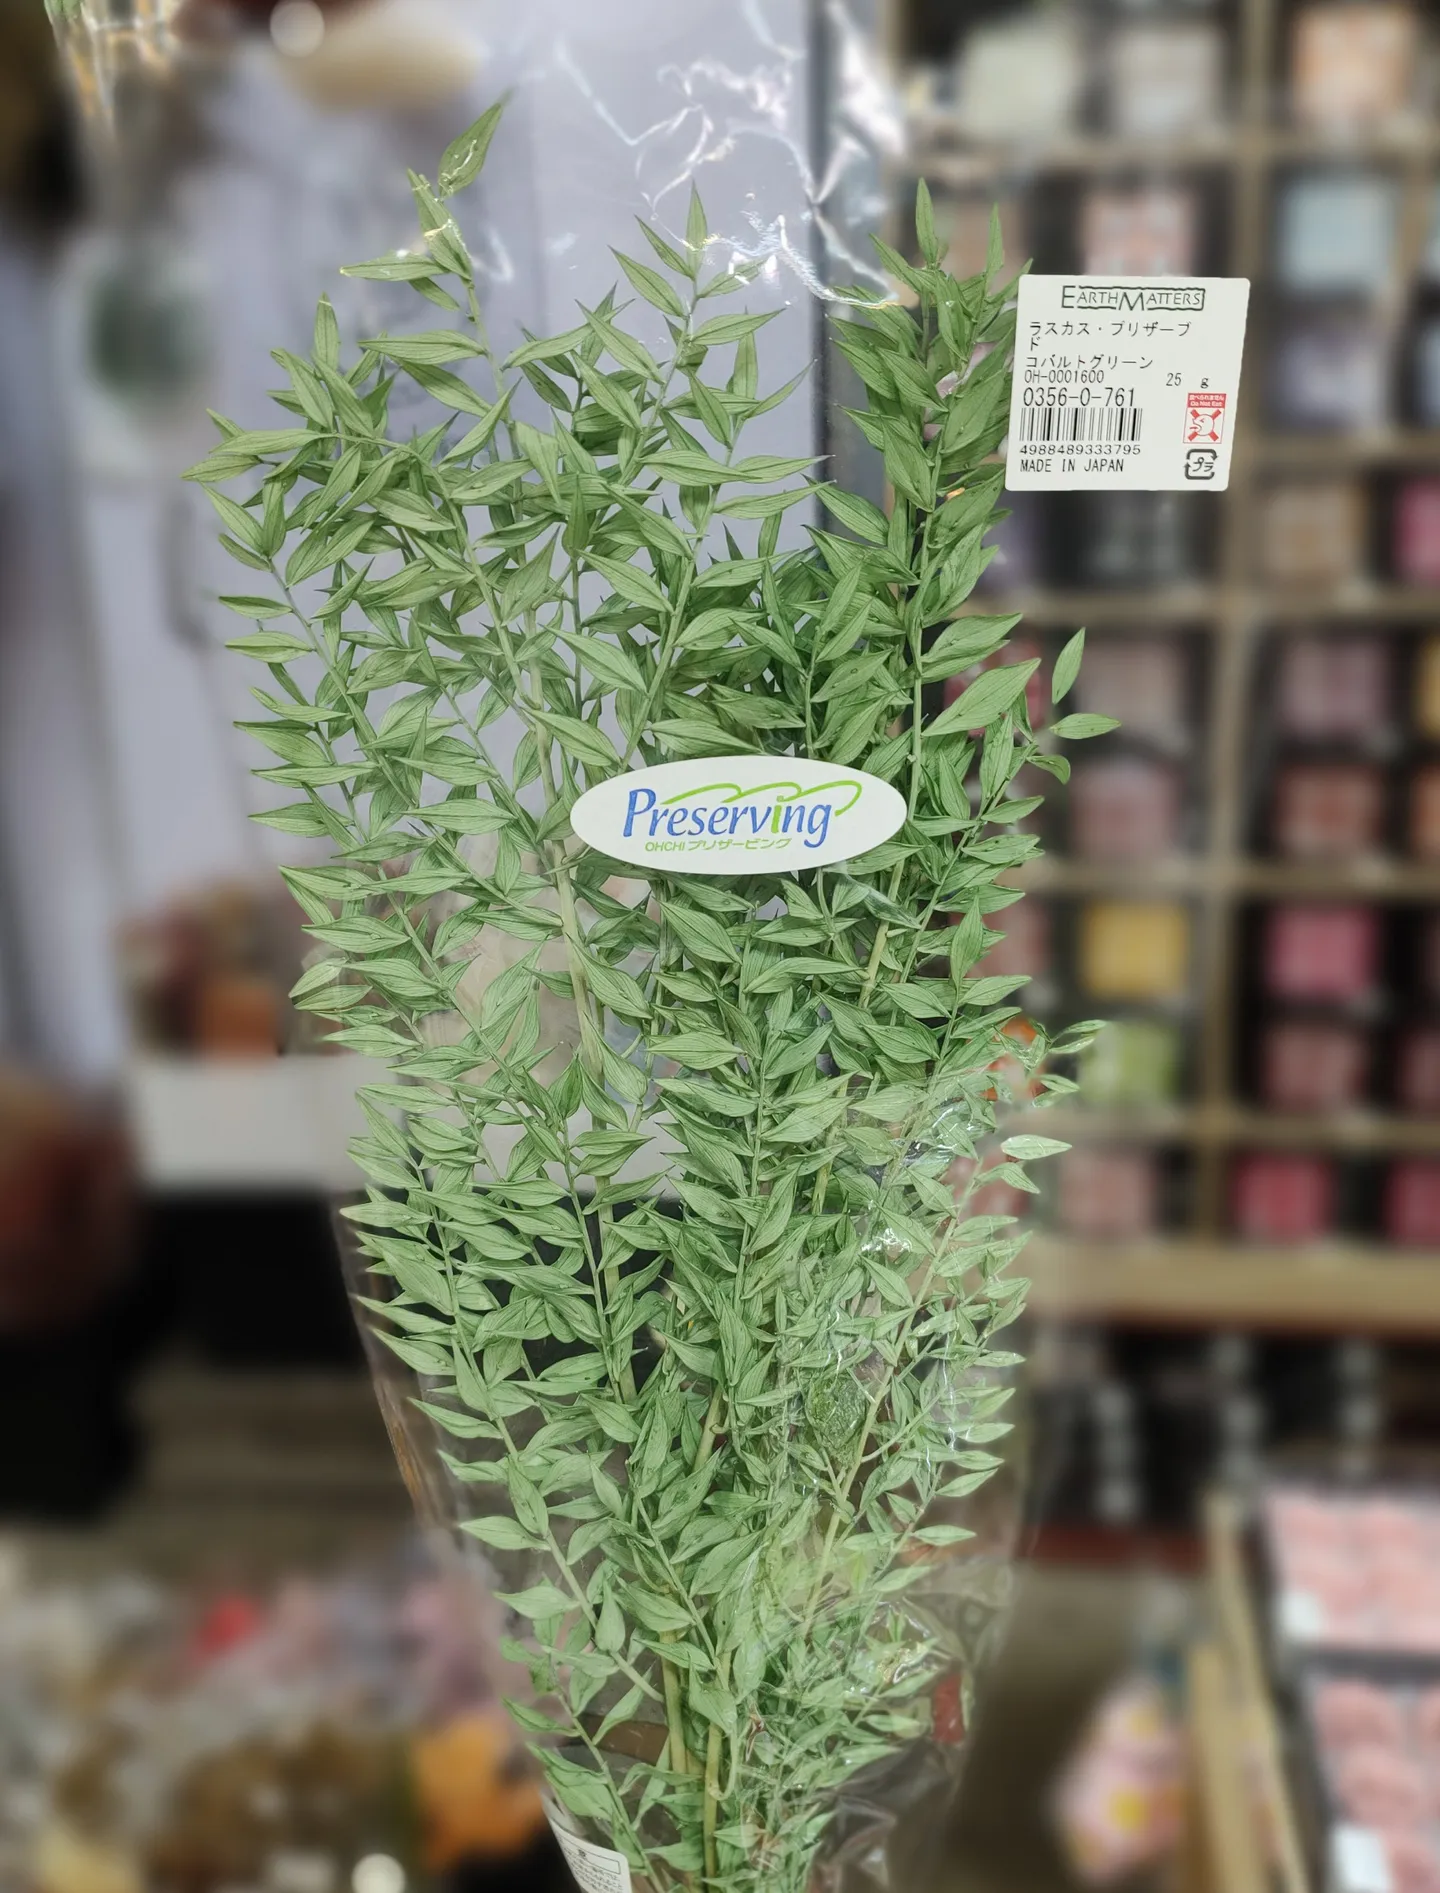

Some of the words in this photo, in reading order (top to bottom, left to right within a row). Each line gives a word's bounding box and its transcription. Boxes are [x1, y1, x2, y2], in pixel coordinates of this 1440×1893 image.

[1029, 337, 1041, 351] ド
[1026, 355, 1154, 370] コバルトグリーン
[1165, 372, 1183, 387] 25
[1200, 376, 1210, 389] g
[1023, 387, 1136, 407] 0356-0-761
[1020, 444, 1141, 455] 4988489333795
[1020, 459, 1052, 473] MADE
[1062, 459, 1076, 473] IN
[1084, 459, 1125, 473] JAPAN
[622, 788, 833, 849] Preserving
[645, 841, 686, 852] OHCHI
[688, 837, 793, 851] プリザービング
